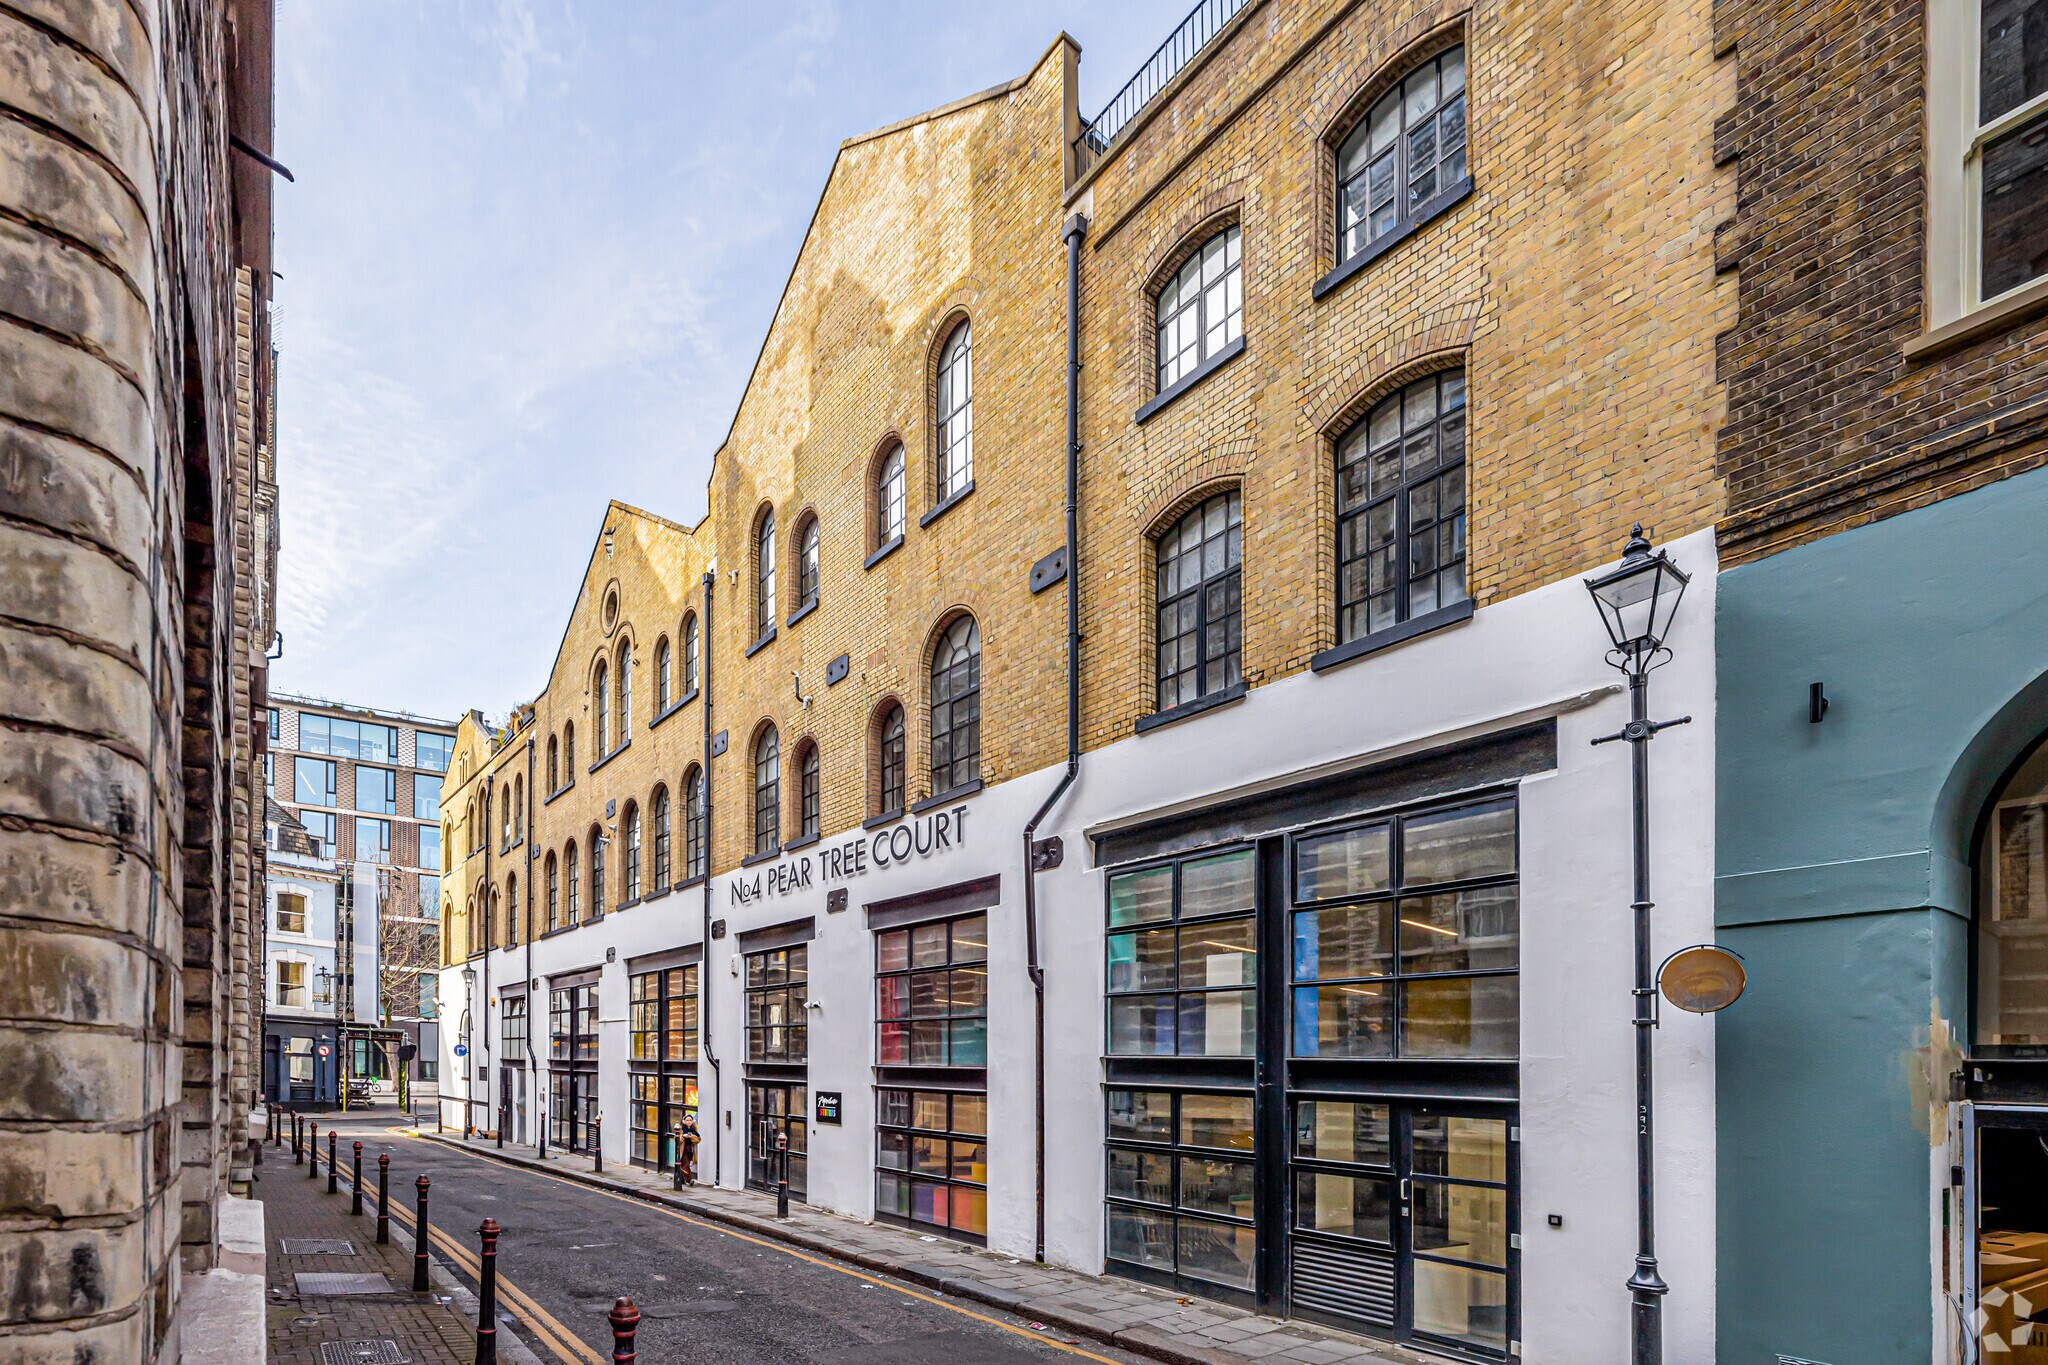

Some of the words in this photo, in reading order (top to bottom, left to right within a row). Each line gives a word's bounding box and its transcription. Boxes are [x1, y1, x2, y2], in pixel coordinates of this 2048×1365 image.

[768, 857, 811, 895] PEAR
[818, 838, 866, 881] TREE
[872, 804, 967, 866] COURT
[1639, 1105, 1648, 1135] 392
